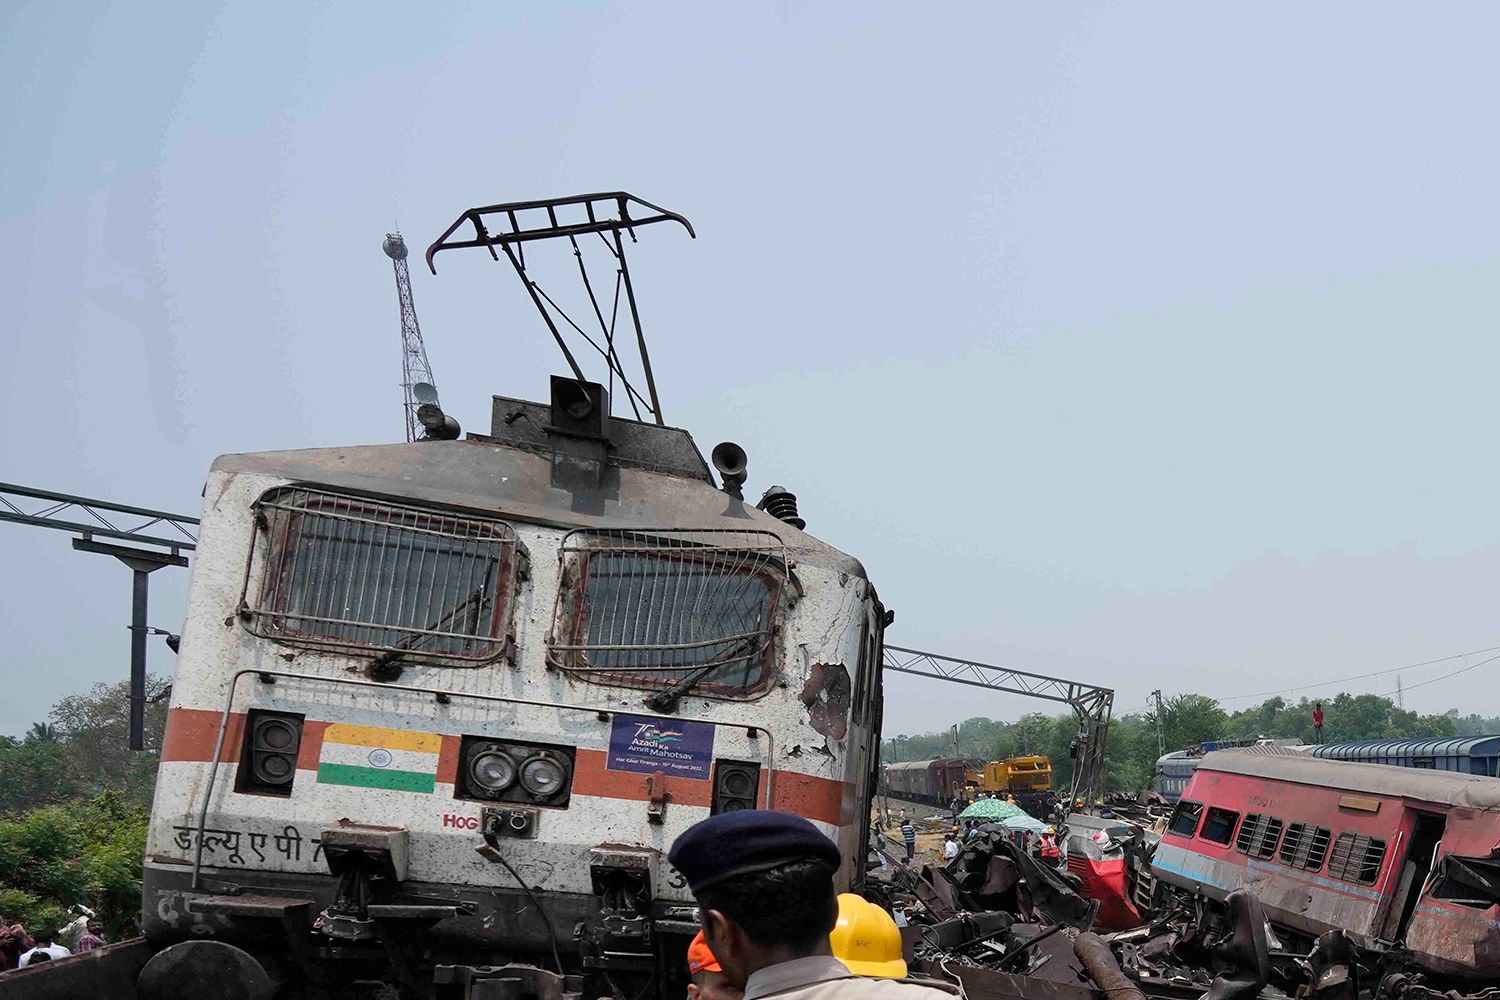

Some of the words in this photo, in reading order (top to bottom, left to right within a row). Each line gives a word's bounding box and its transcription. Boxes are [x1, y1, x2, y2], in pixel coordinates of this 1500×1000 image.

[631, 738, 658, 748] Azadi
[628, 745, 650, 753] Amrit
[649, 748, 694, 760] Mahotsav
[443, 814, 479, 830] HOG
[248, 833, 268, 862] ए
[274, 825, 302, 861] पी
